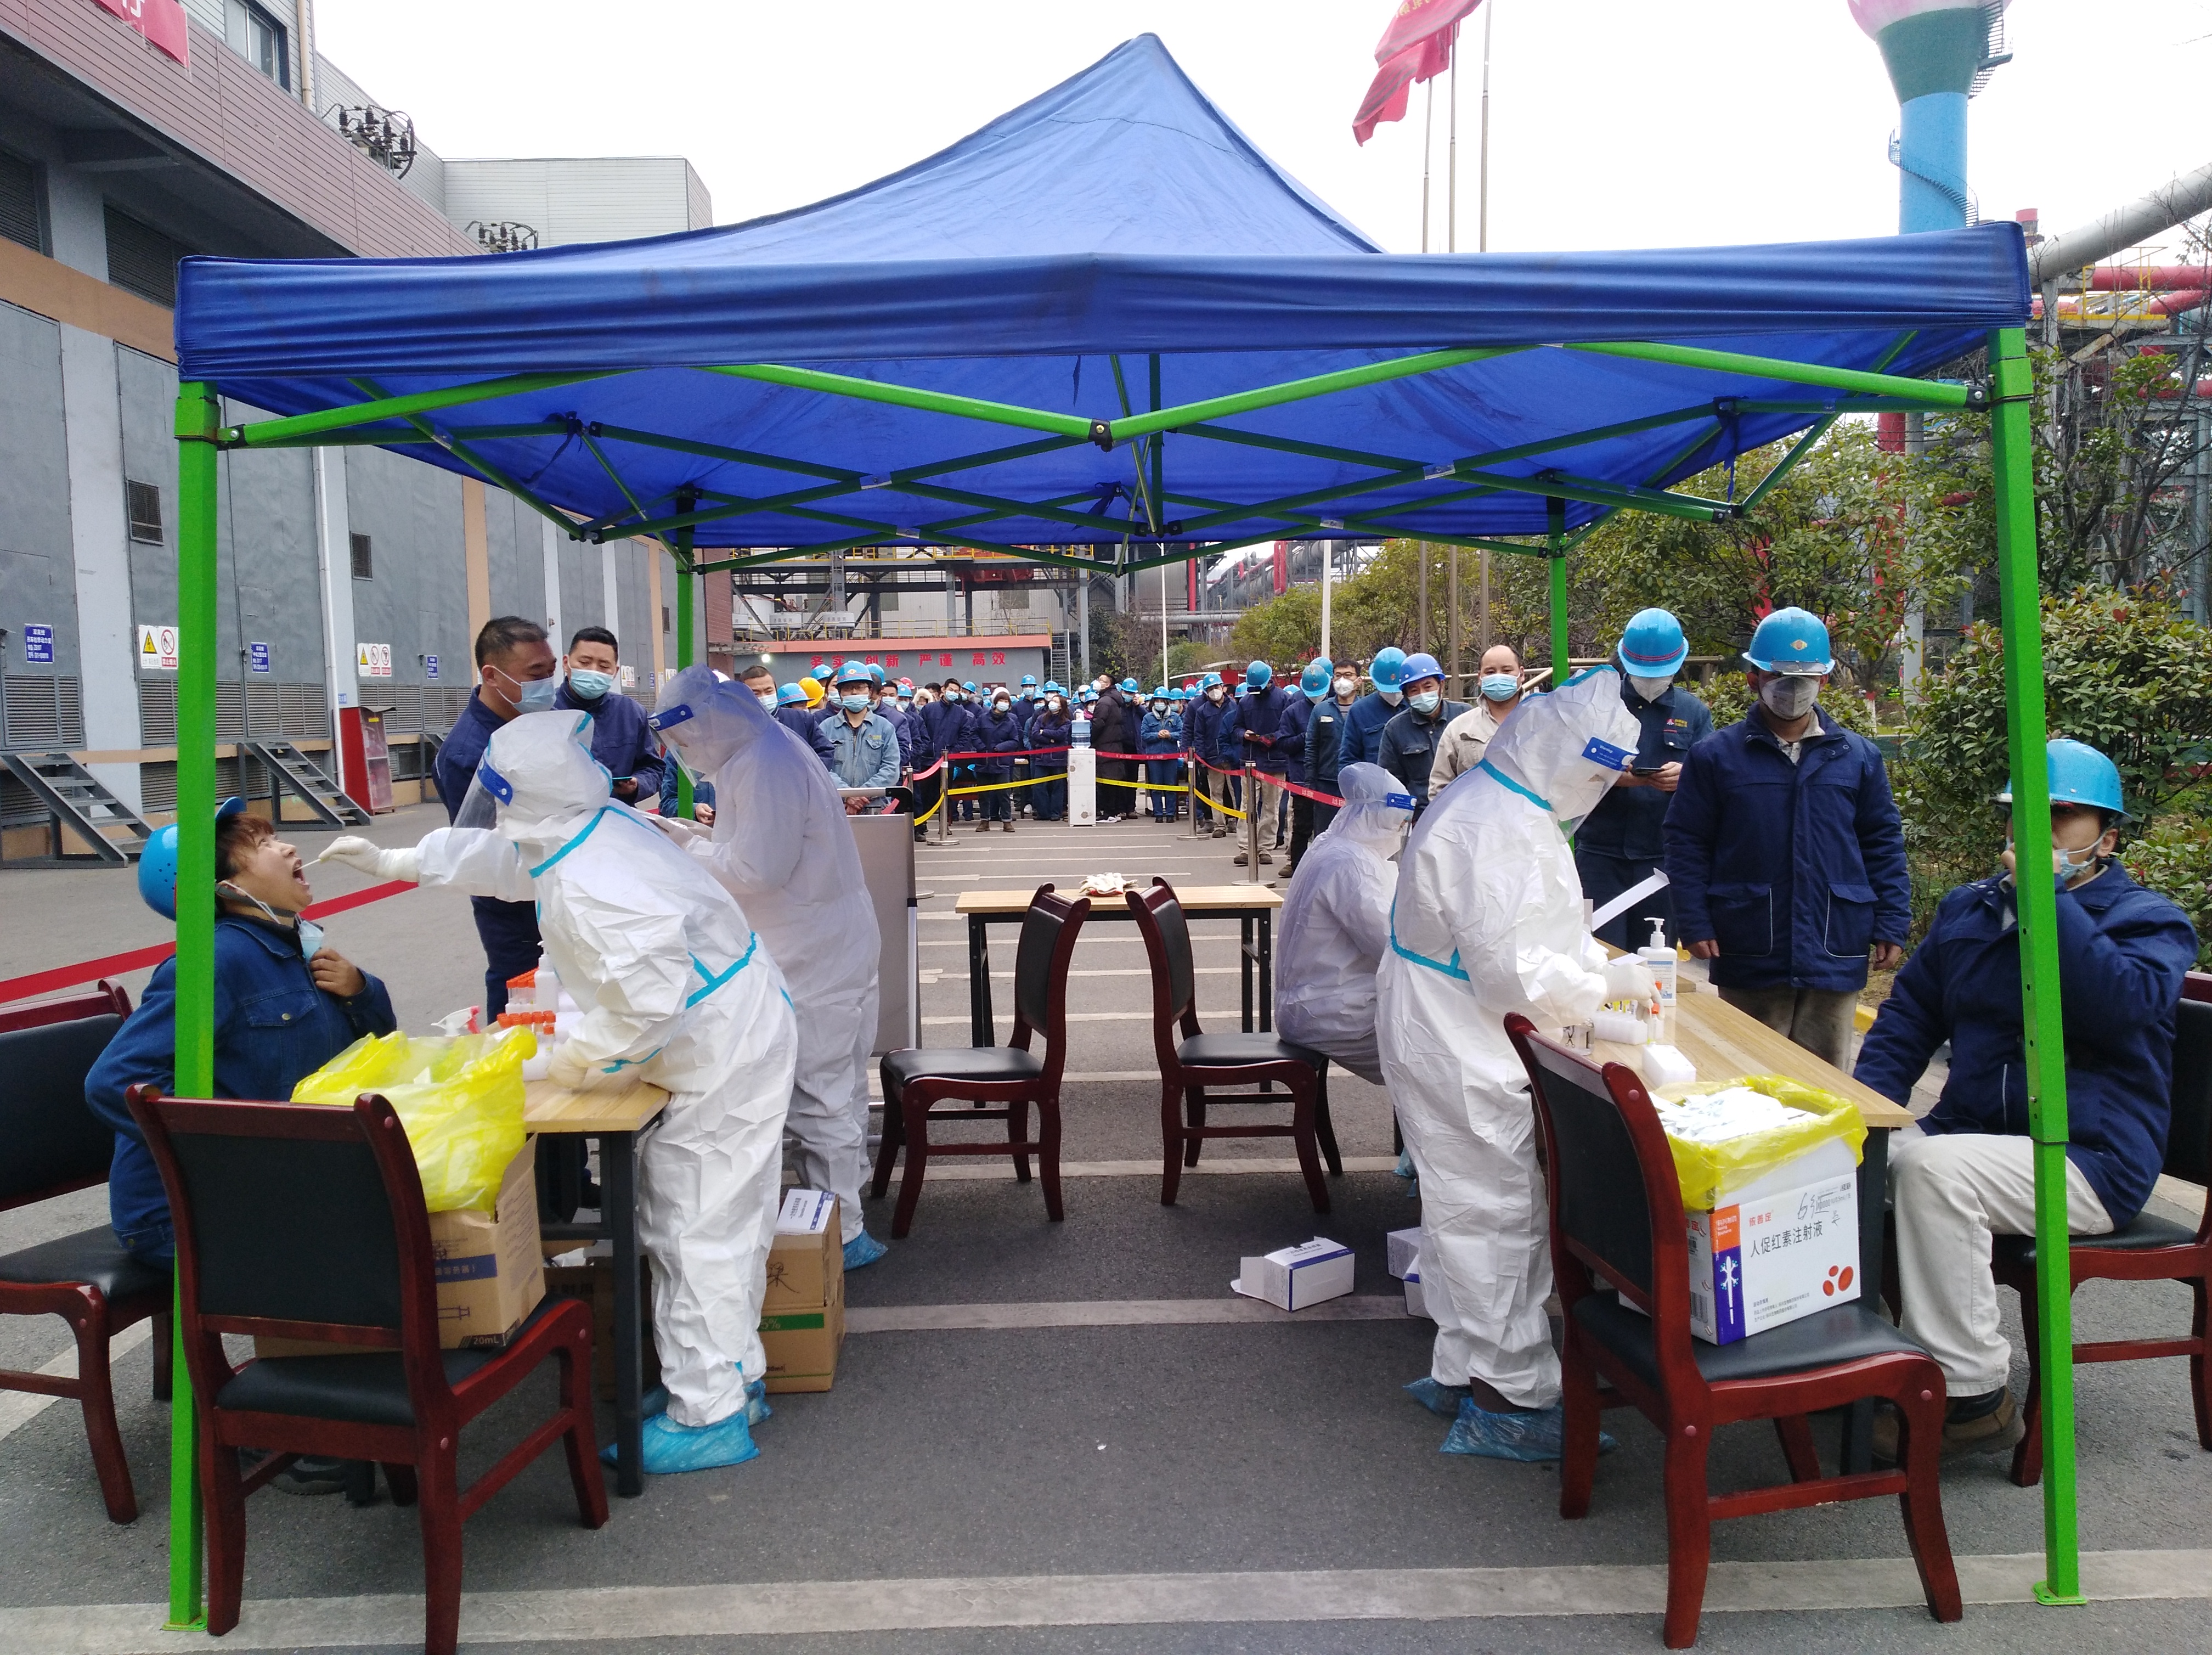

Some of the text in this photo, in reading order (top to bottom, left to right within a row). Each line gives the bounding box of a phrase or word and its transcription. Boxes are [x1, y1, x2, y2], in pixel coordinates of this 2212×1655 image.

[865, 654, 899, 668] 创新
[918, 653, 953, 667] 严谨
[972, 651, 1006, 666] 高效
[1751, 1220, 1823, 1258] 人促红素注射液
[473, 1336, 499, 1346] 20mL
